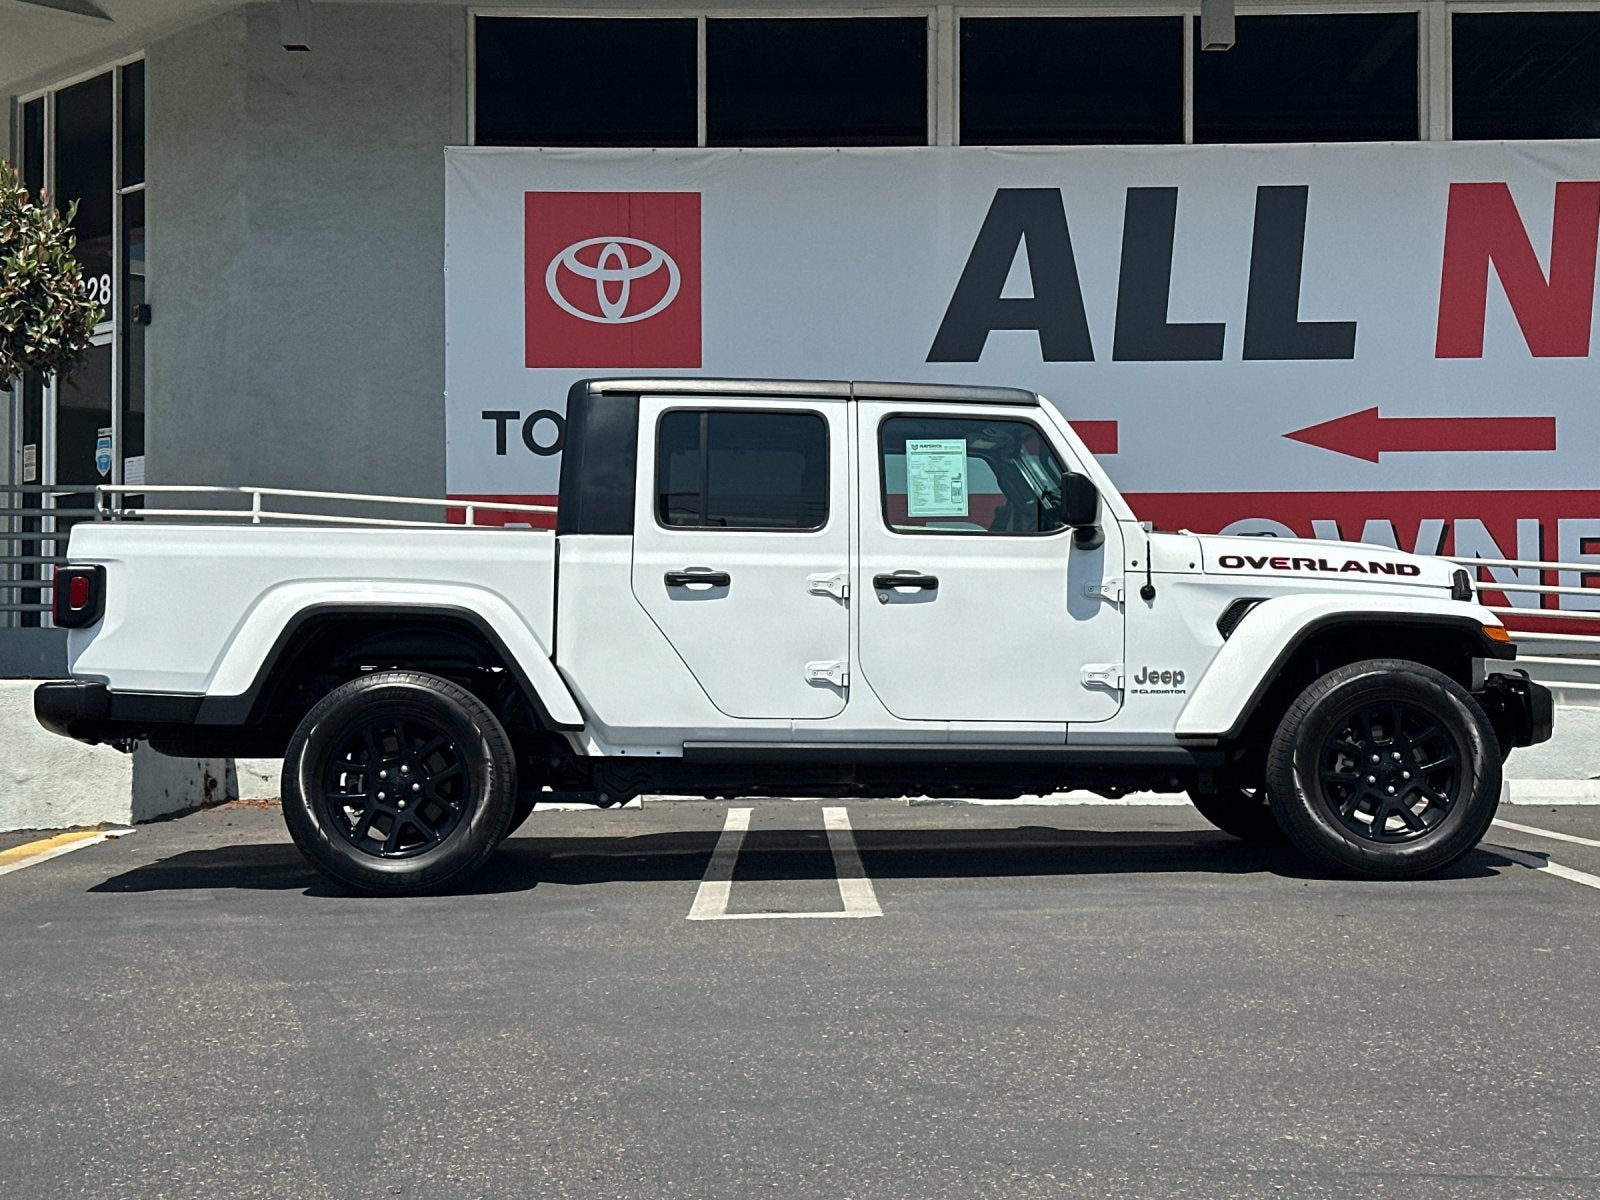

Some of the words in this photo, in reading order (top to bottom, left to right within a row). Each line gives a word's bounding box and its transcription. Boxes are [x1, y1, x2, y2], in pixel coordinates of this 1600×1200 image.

[926, 185, 1357, 362] ALL
[1435, 182, 1600, 358] N
[482, 409, 566, 456] TO
[1217, 518, 1600, 612] NE
[1218, 555, 1421, 577] OVERLAND
[1134, 666, 1185, 688] Jeep
